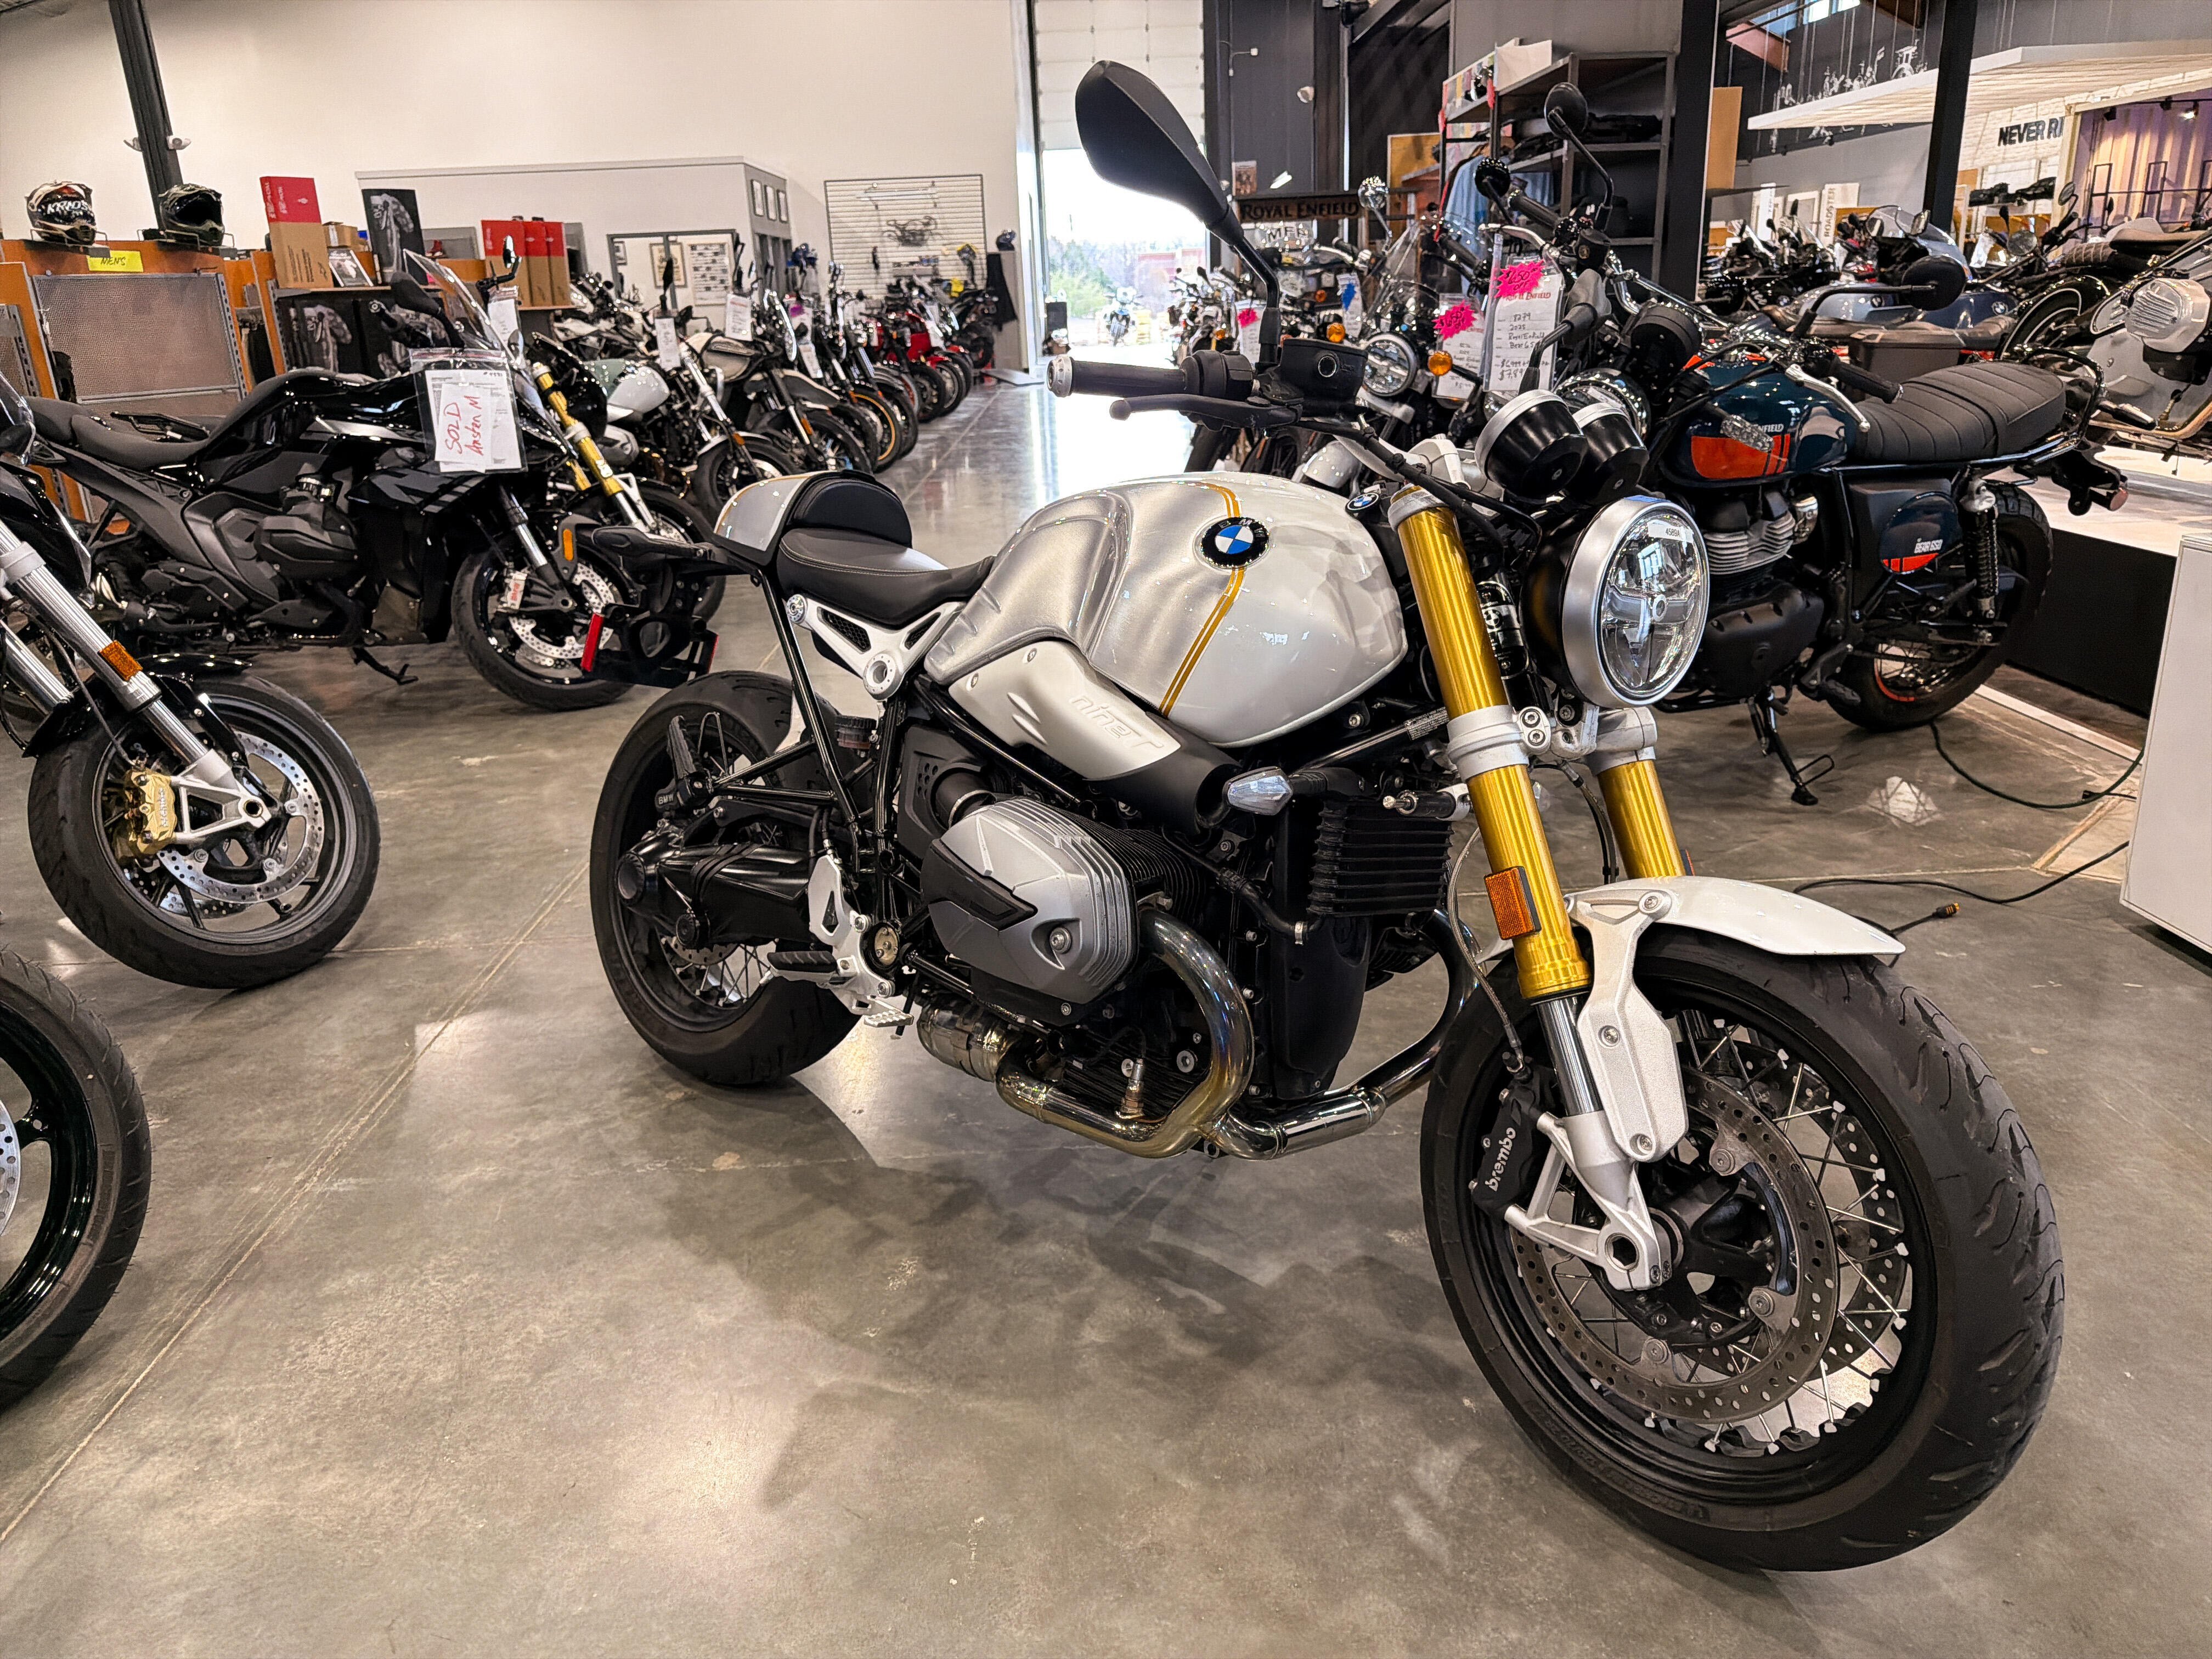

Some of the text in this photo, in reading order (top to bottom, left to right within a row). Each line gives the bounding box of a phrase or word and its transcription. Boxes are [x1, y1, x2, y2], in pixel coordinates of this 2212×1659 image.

[1997, 120, 2046, 146] NEVER
[1241, 202, 1359, 219] ROYAL ENFIELD
[1824, 187, 1836, 238] ROADSTER
[443, 402, 463, 455] SOLD
[1665, 528, 1680, 537] 4589A
[658, 794, 674, 805] BMW
[1485, 1127, 1516, 1192] brembo
